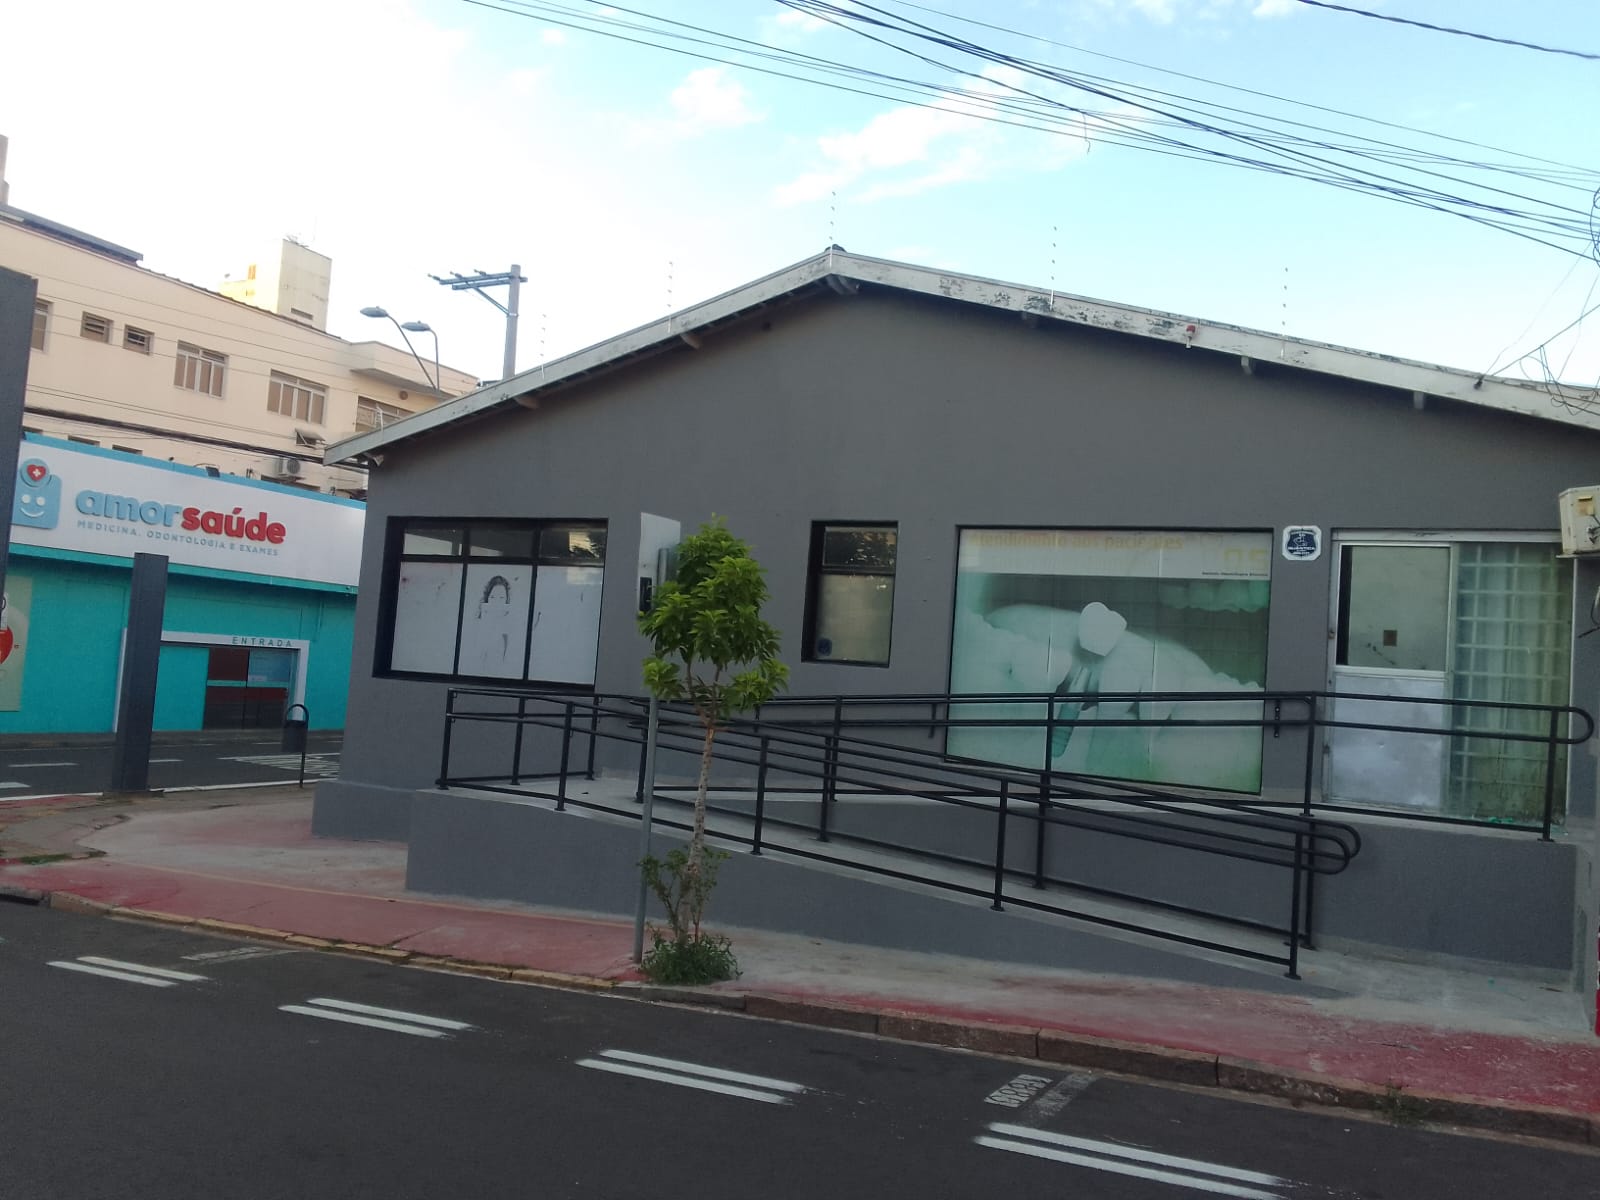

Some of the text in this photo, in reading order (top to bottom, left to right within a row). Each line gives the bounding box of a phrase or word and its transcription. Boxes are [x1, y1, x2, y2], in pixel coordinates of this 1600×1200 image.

[75, 489, 286, 544] amorsaúde
[146, 530, 226, 549] ODONTOLOGIA
[229, 543, 235, 551] E
[239, 544, 279, 557] EXAMES
[231, 636, 292, 648] ENTRADA
